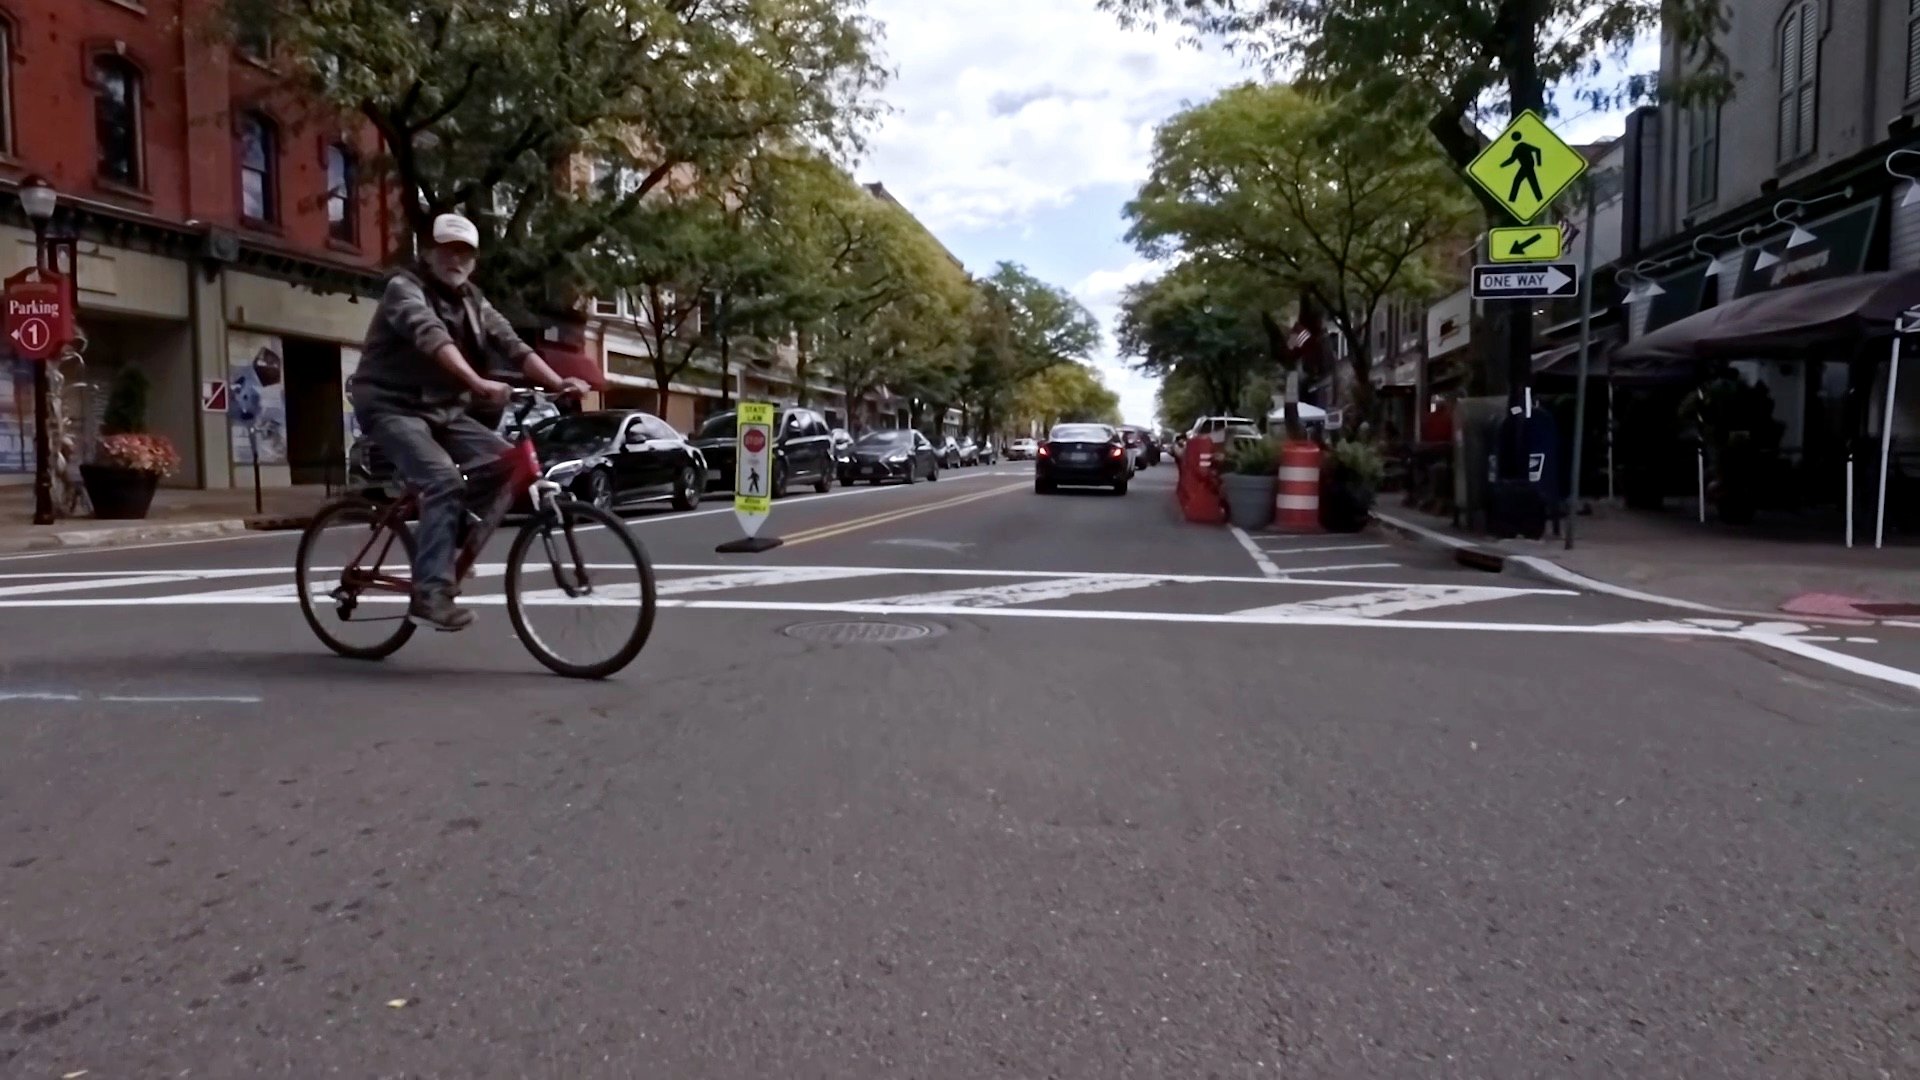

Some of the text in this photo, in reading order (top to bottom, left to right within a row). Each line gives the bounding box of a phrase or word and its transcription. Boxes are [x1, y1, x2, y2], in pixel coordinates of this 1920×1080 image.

[1484, 274, 1545, 287] ONE WAY
[10, 300, 59, 318] Parking
[28, 323, 38, 345] 1
